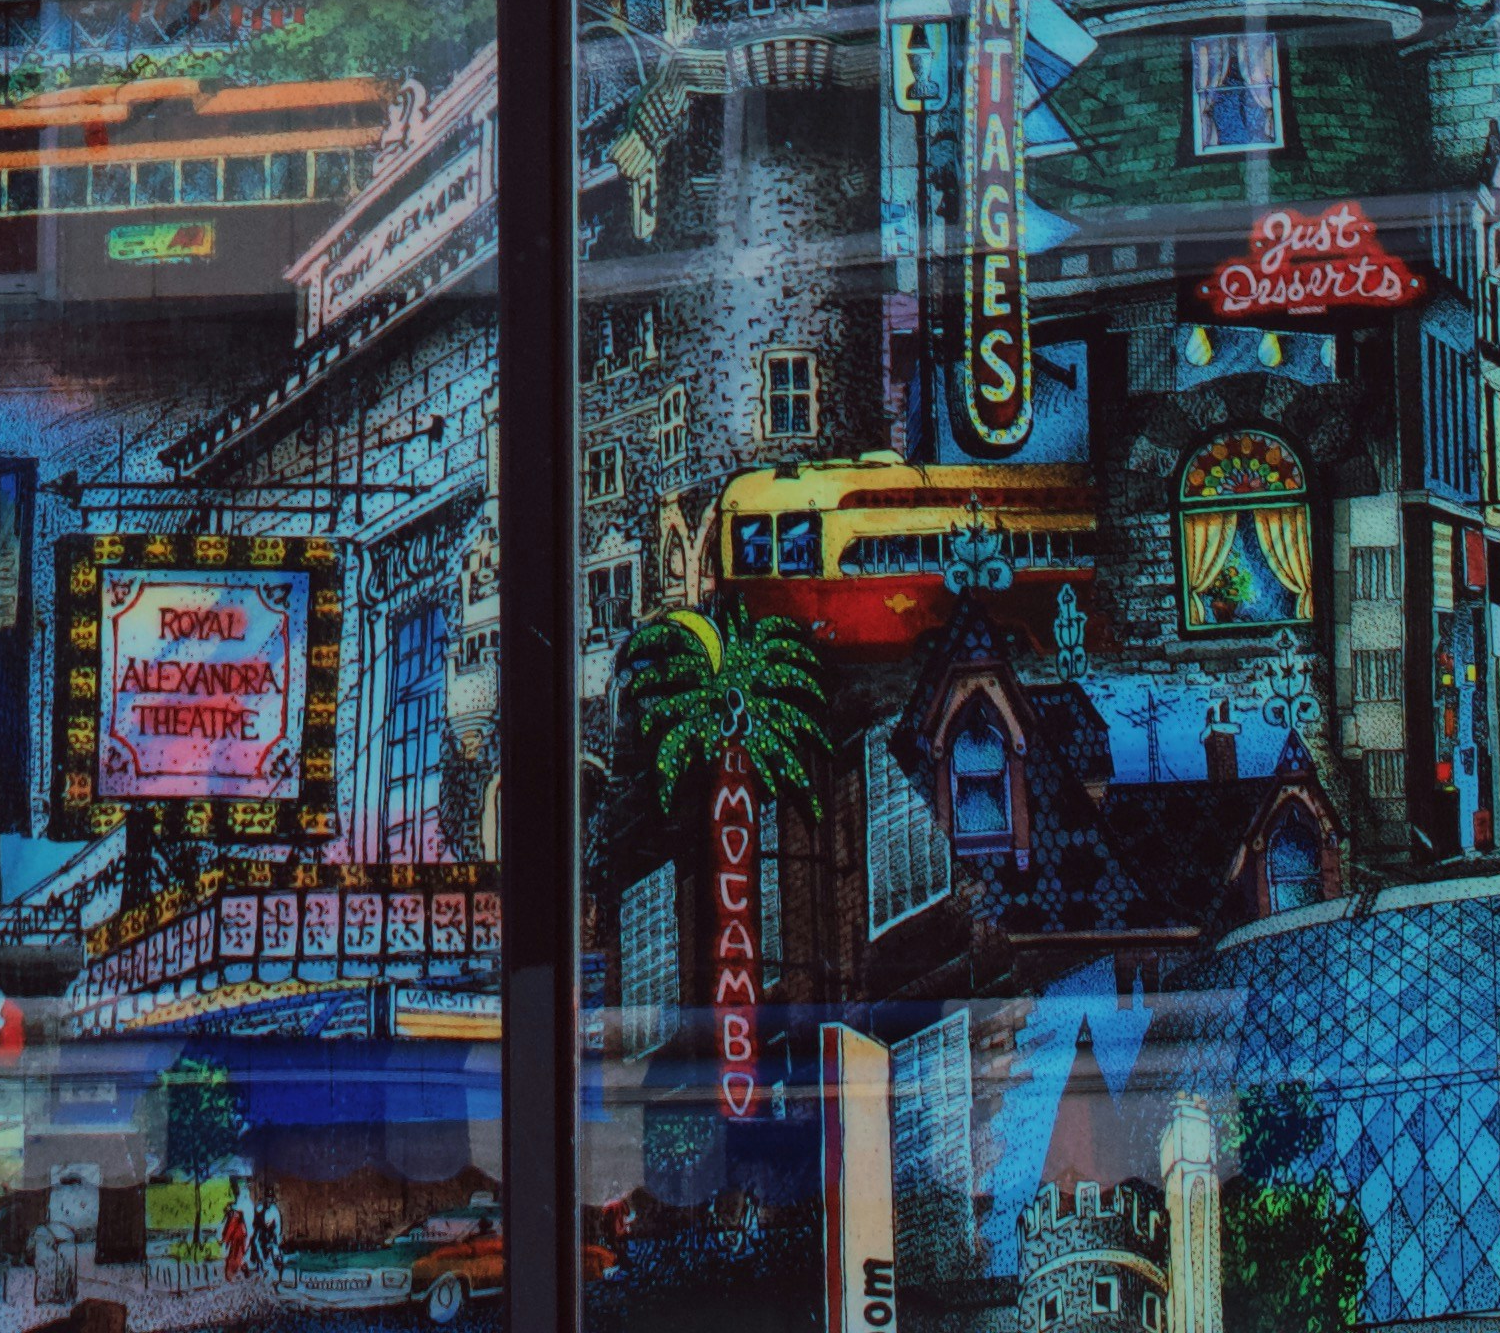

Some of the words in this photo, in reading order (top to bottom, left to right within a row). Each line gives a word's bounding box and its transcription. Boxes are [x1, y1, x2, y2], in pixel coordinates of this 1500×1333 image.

[1259, 205, 1362, 274] Just
[1219, 255, 1402, 312] Desserts
[158, 607, 245, 641] ROYAL
[119, 657, 283, 695] ALEXANDRA
[131, 704, 261, 741] THEATRE
[724, 753, 747, 774] EL
[713, 786, 756, 1117] MOCAMBO
[406, 989, 487, 1011] VARSITY
